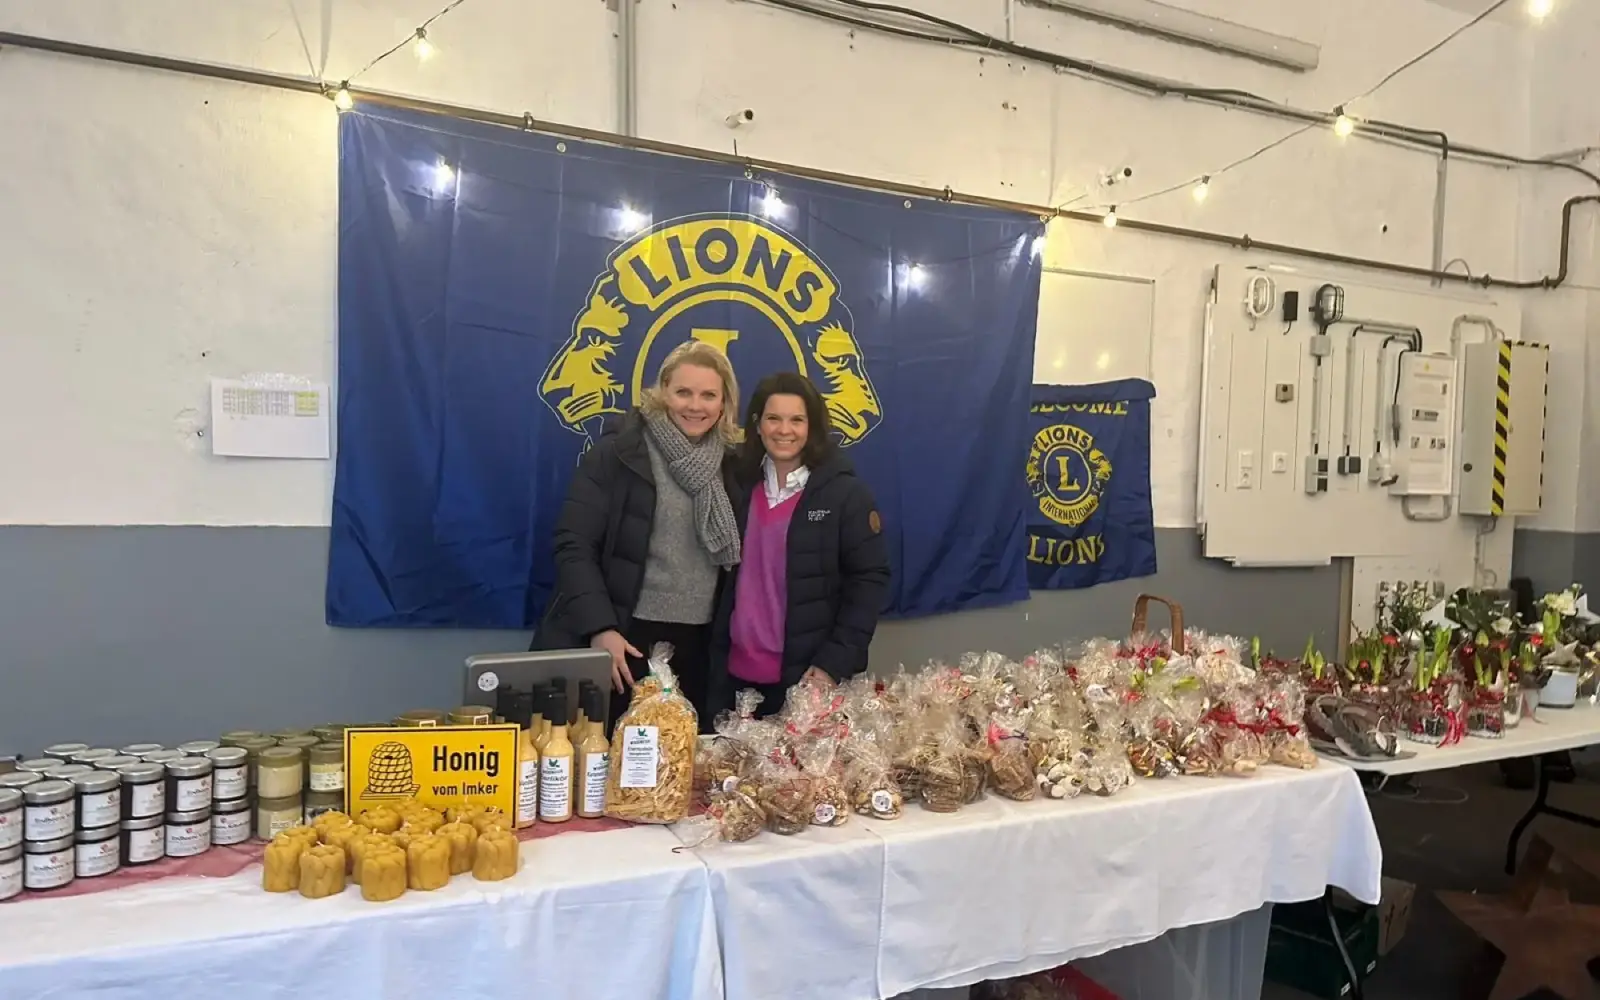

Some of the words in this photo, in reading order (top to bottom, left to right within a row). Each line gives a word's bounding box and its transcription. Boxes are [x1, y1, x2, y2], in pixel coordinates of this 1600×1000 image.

[628, 227, 823, 314] LIONS
[1037, 427, 1090, 450] LIONS
[1056, 456, 1081, 491] L
[1027, 533, 1105, 566] LIONS
[433, 745, 499, 777] Honig
[432, 785, 458, 796] vom
[463, 781, 498, 796] Imker
